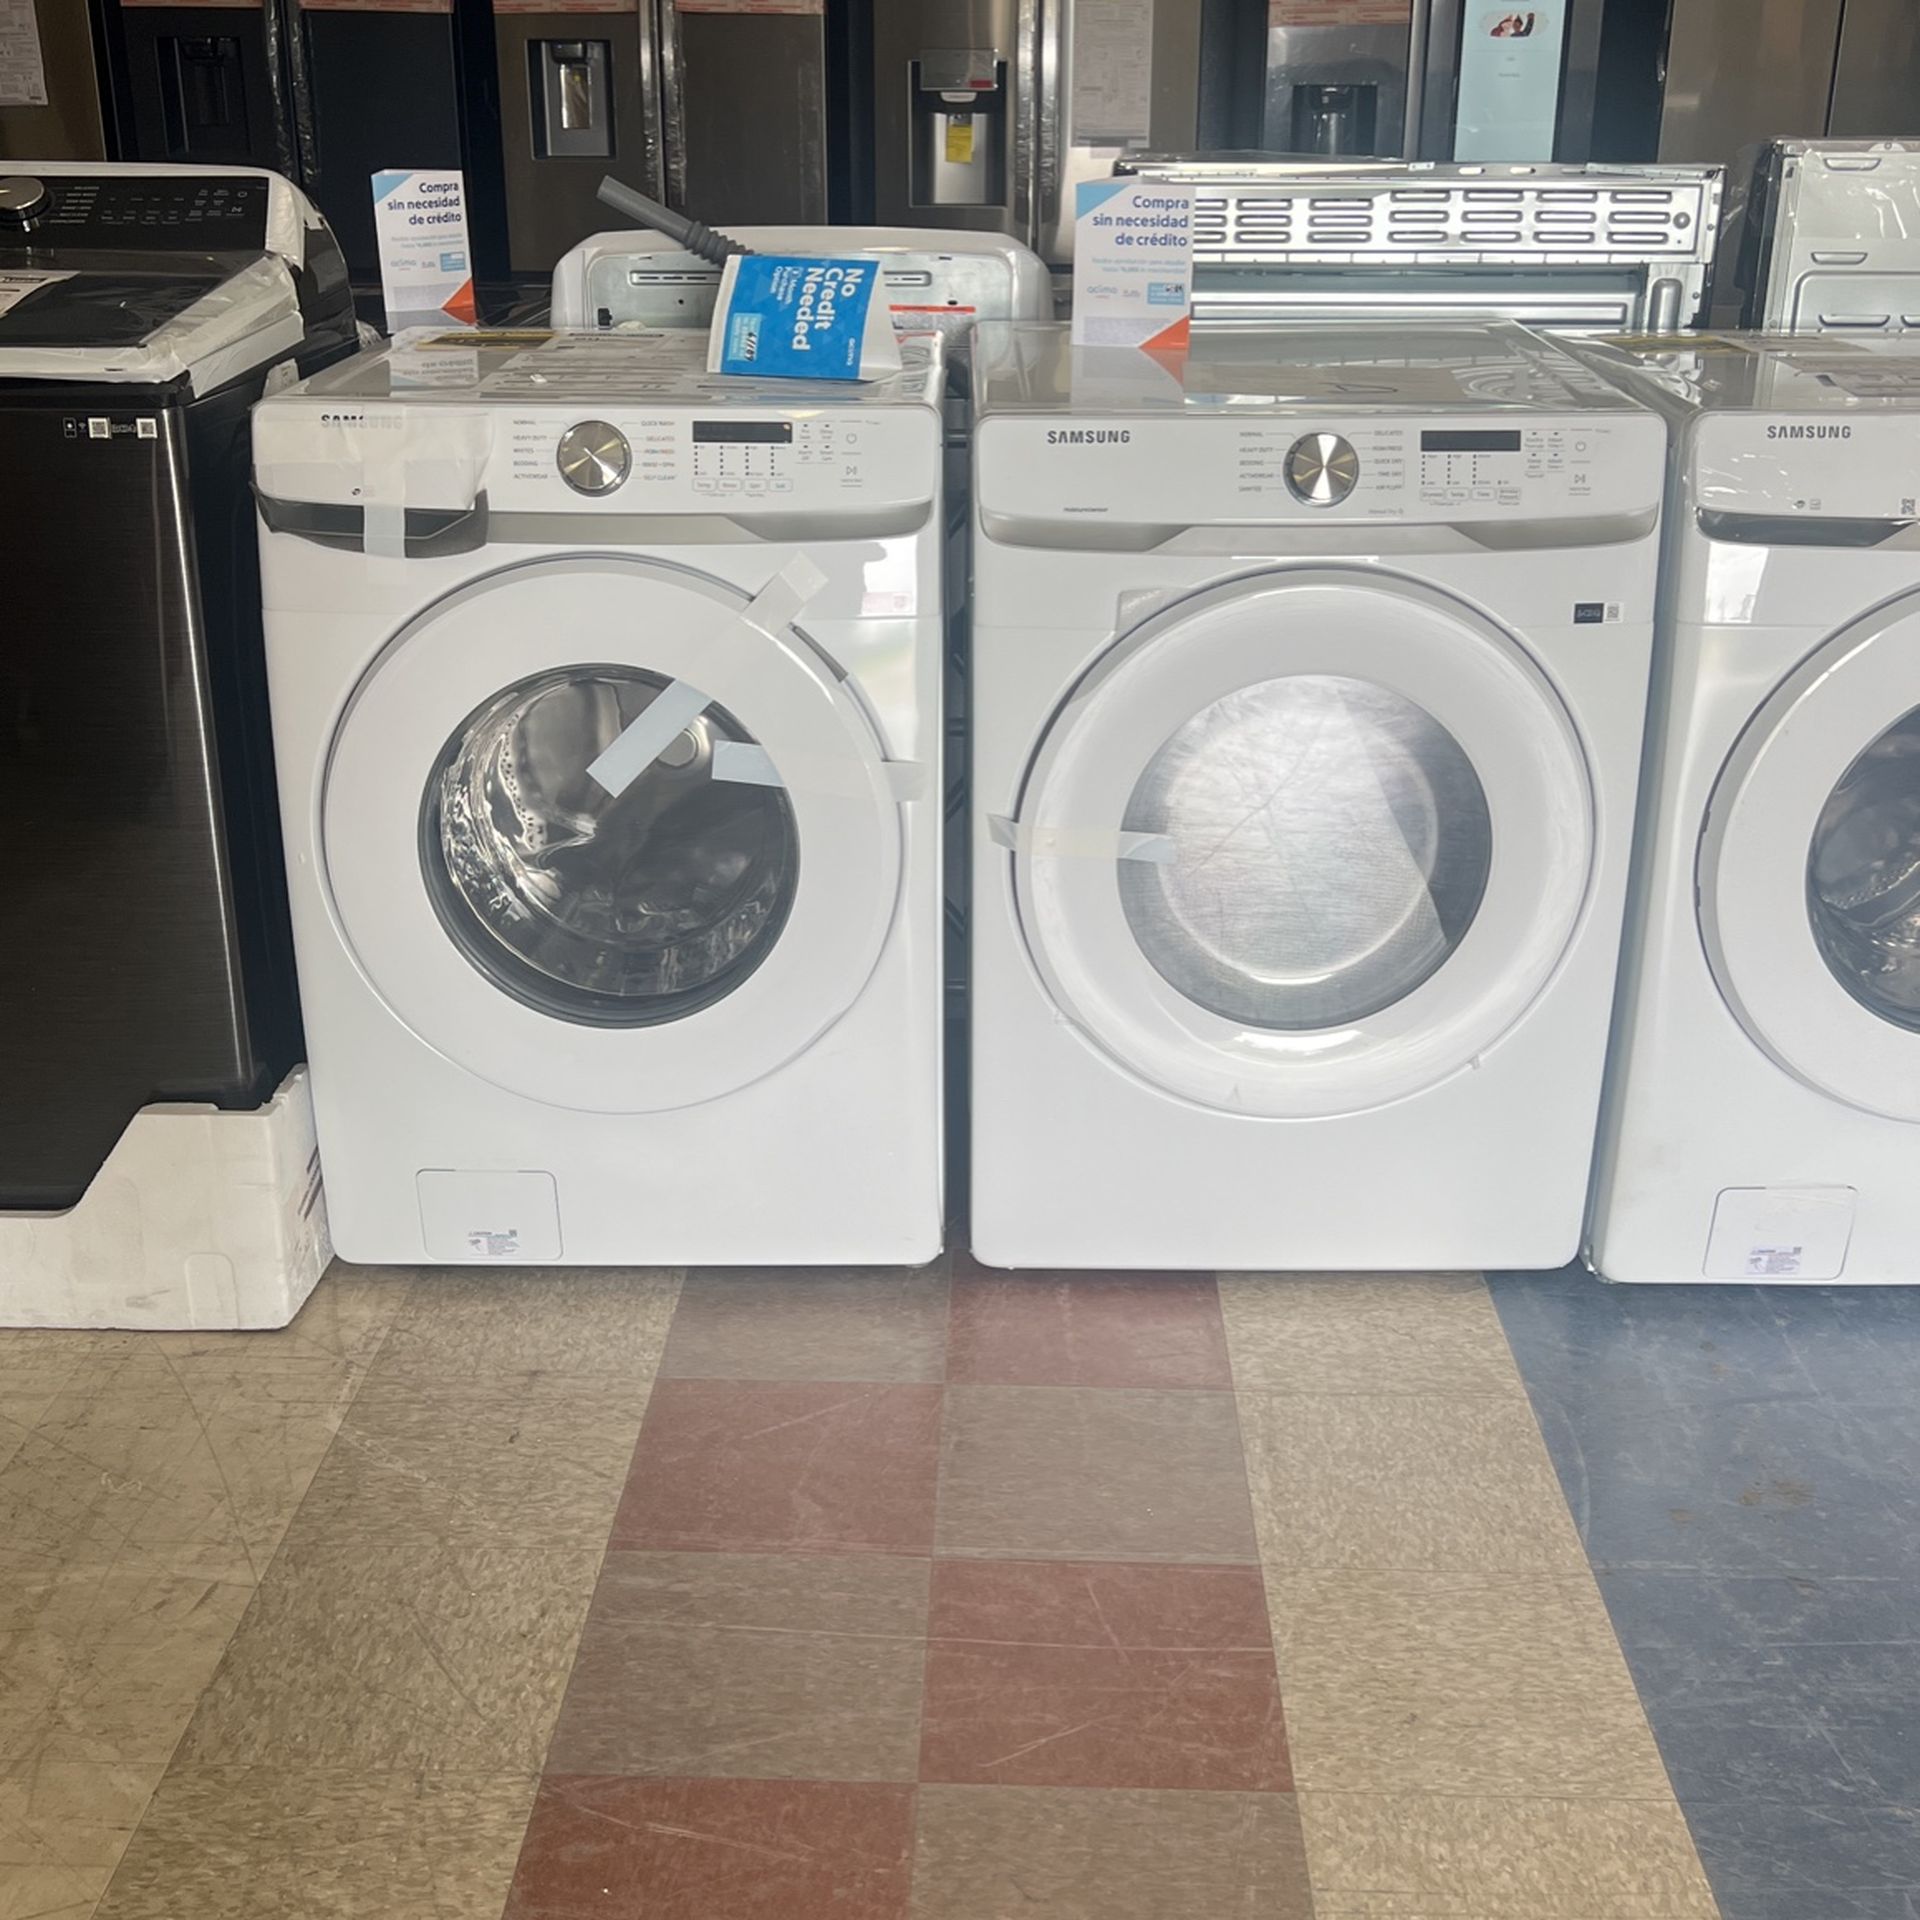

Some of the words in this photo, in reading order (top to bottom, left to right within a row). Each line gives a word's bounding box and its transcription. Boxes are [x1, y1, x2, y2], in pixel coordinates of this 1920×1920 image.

[419, 182, 459, 194] Compra
[388, 199, 405, 211] sin
[407, 196, 461, 210] necesidad
[1132, 195, 1190, 211] Compra
[409, 214, 425, 225] de
[427, 211, 462, 225] crédito
[1092, 213, 1113, 227] sin
[1115, 212, 1189, 229] necesidad
[1115, 232, 1134, 246] de
[1136, 232, 1188, 247] crédito
[841, 267, 865, 298] No
[814, 267, 845, 331] Credit
[792, 267, 824, 350] Needed
[1047, 430, 1130, 444] SAMSUNG
[1767, 425, 1852, 438] SAMSUNG
